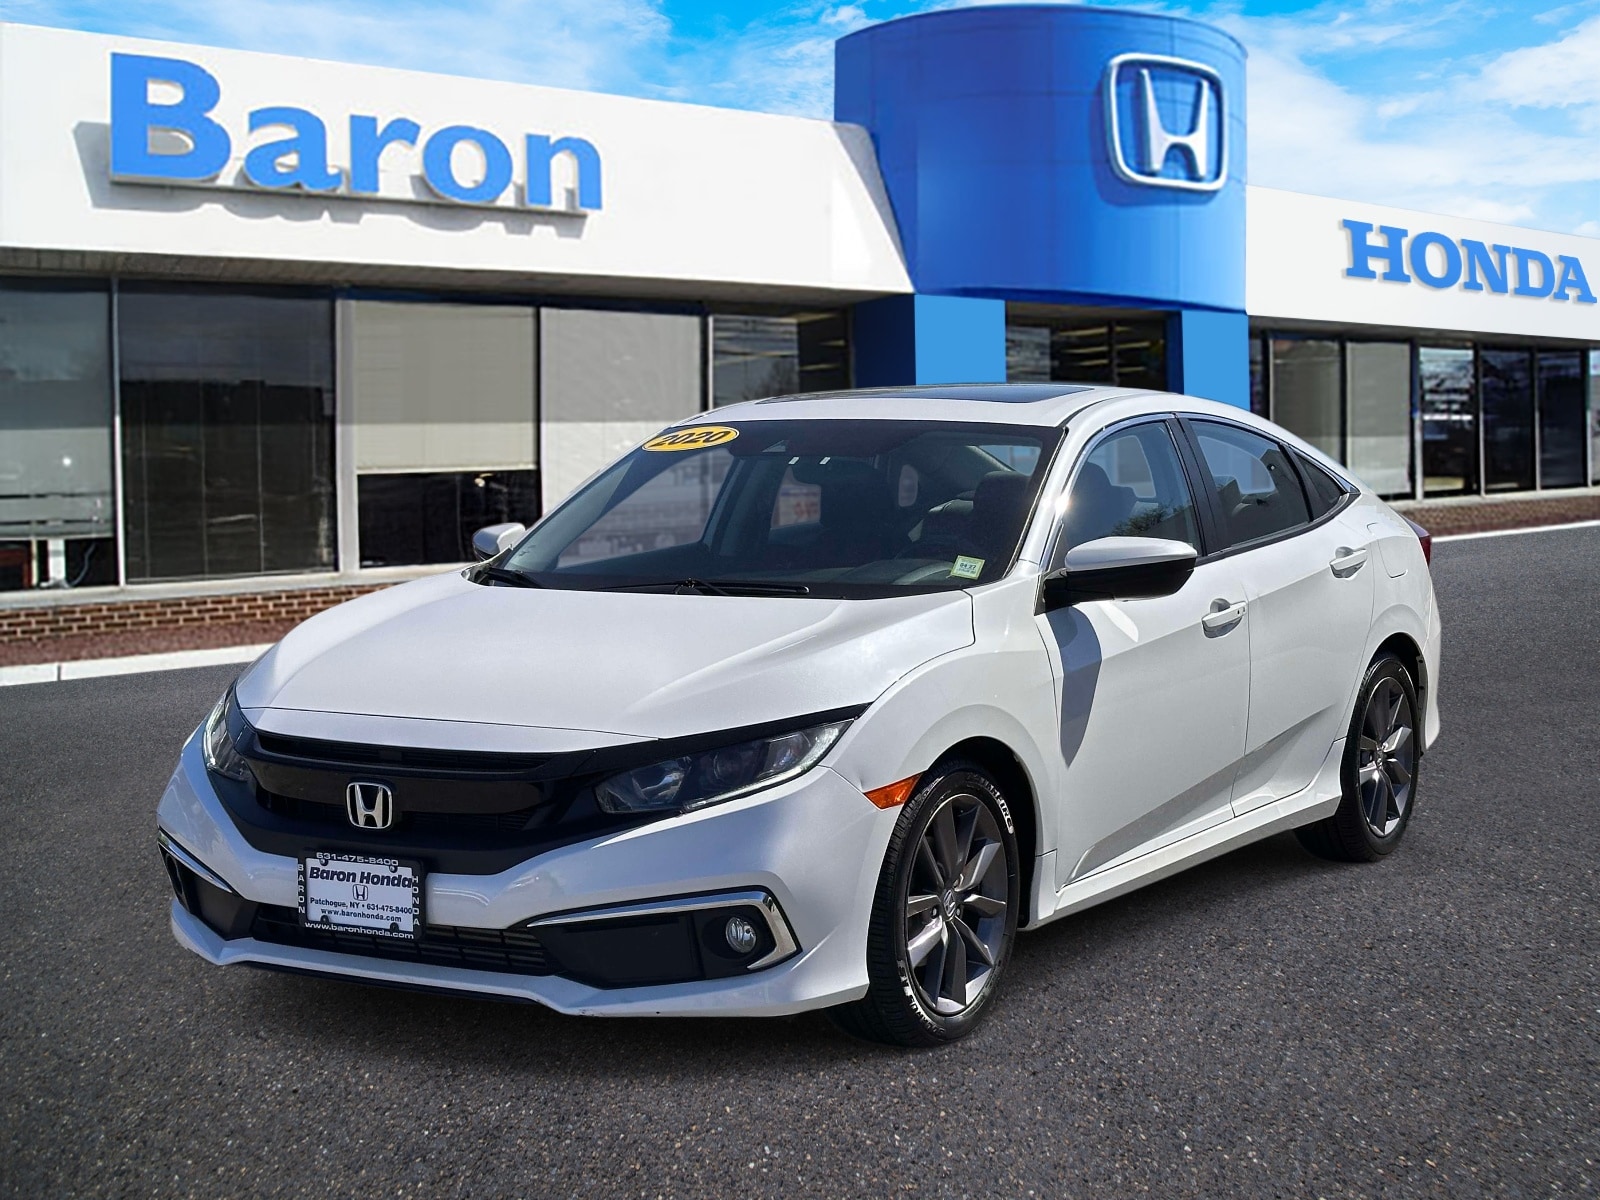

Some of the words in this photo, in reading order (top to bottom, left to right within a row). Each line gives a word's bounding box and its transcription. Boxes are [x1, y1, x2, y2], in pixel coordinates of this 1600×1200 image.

[110, 52, 602, 210] Baron
[1342, 219, 1598, 304] HONDA
[647, 430, 732, 448] 2020
[316, 852, 399, 866] 631-475-8400
[309, 866, 357, 883] Baron
[359, 871, 412, 889] Honda
[297, 864, 306, 914] BARON
[310, 897, 348, 909] Patchogue,
[349, 901, 360, 909] NY
[366, 903, 413, 915] 631-475-8400
[411, 875, 420, 926] HONDA
[321, 908, 402, 922] www.baronhonda.com
[304, 921, 414, 939] www.baronhonda.com
